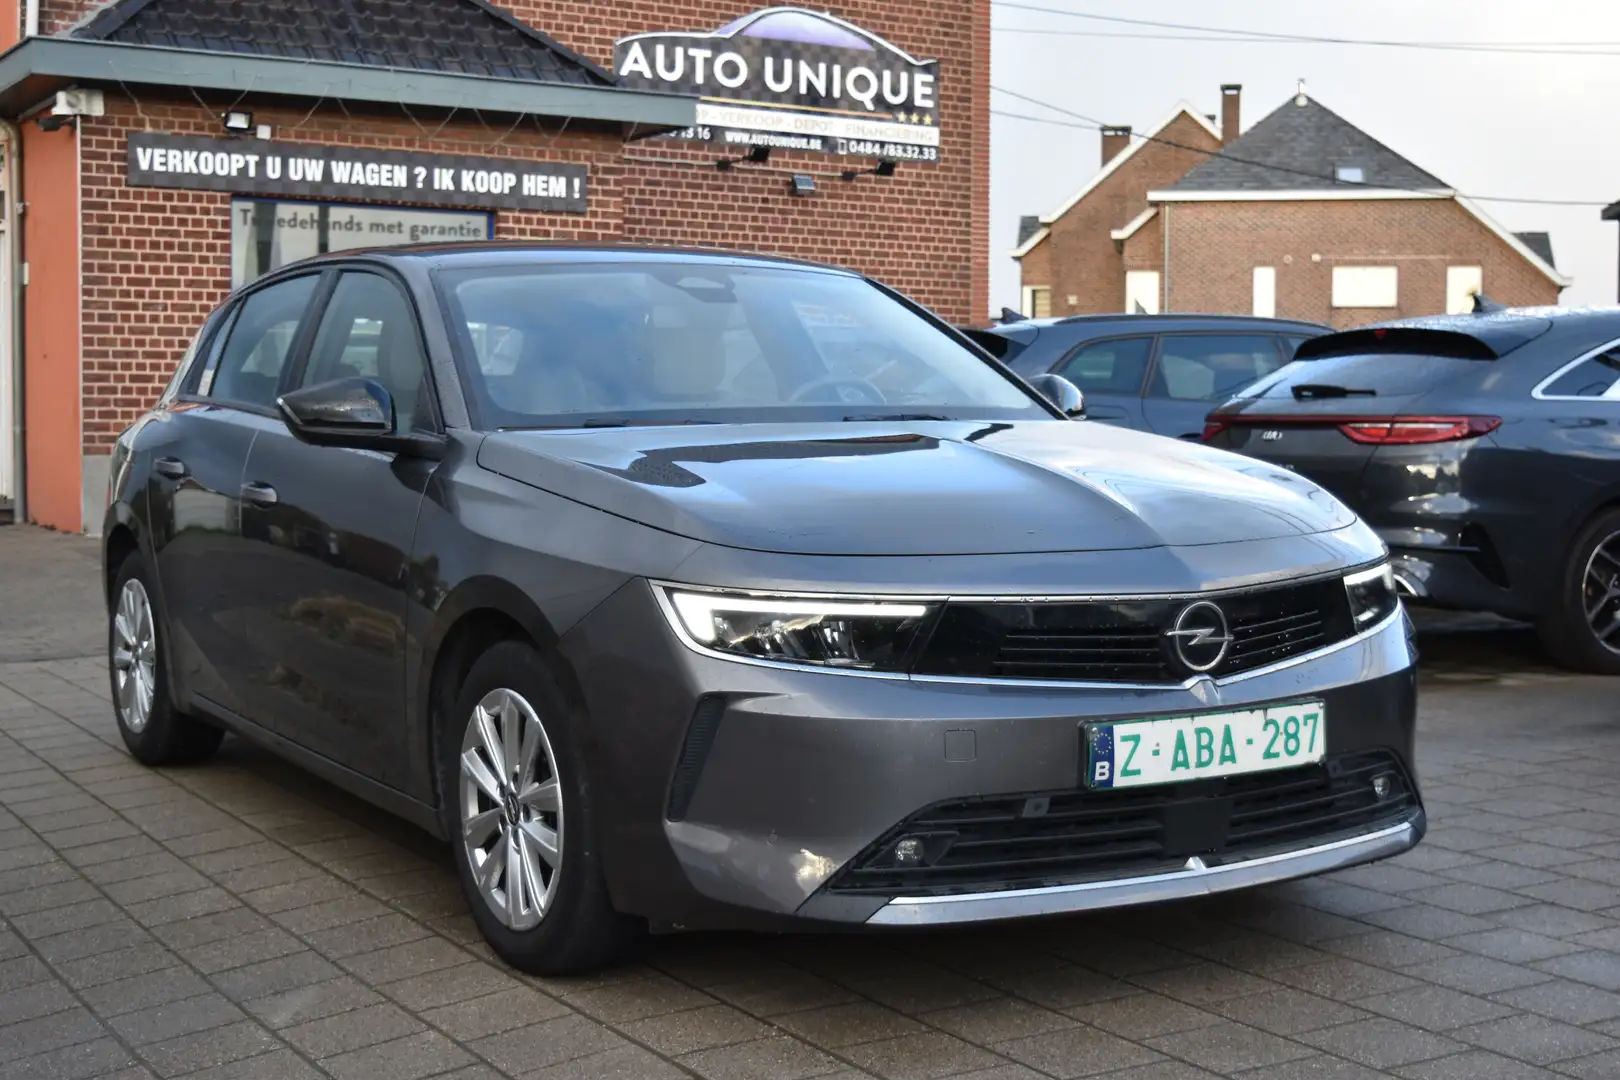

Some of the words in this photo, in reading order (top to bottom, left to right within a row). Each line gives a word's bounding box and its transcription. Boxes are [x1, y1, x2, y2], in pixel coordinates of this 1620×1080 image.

[619, 41, 749, 88] AUTO
[763, 56, 935, 111] UNIQUE
[848, 140, 881, 156] 0484
[136, 147, 260, 178] VERKOOPT
[265, 156, 282, 180] U
[288, 157, 325, 182] UW
[331, 160, 408, 188] WAGEN
[413, 166, 428, 189] ?
[433, 167, 455, 190] IK
[461, 169, 517, 194] KOOP
[522, 174, 567, 198] HEM
[573, 177, 581, 199] !
[369, 221, 404, 235] met
[410, 220, 481, 242] garantie
[1095, 761, 1109, 781] B
